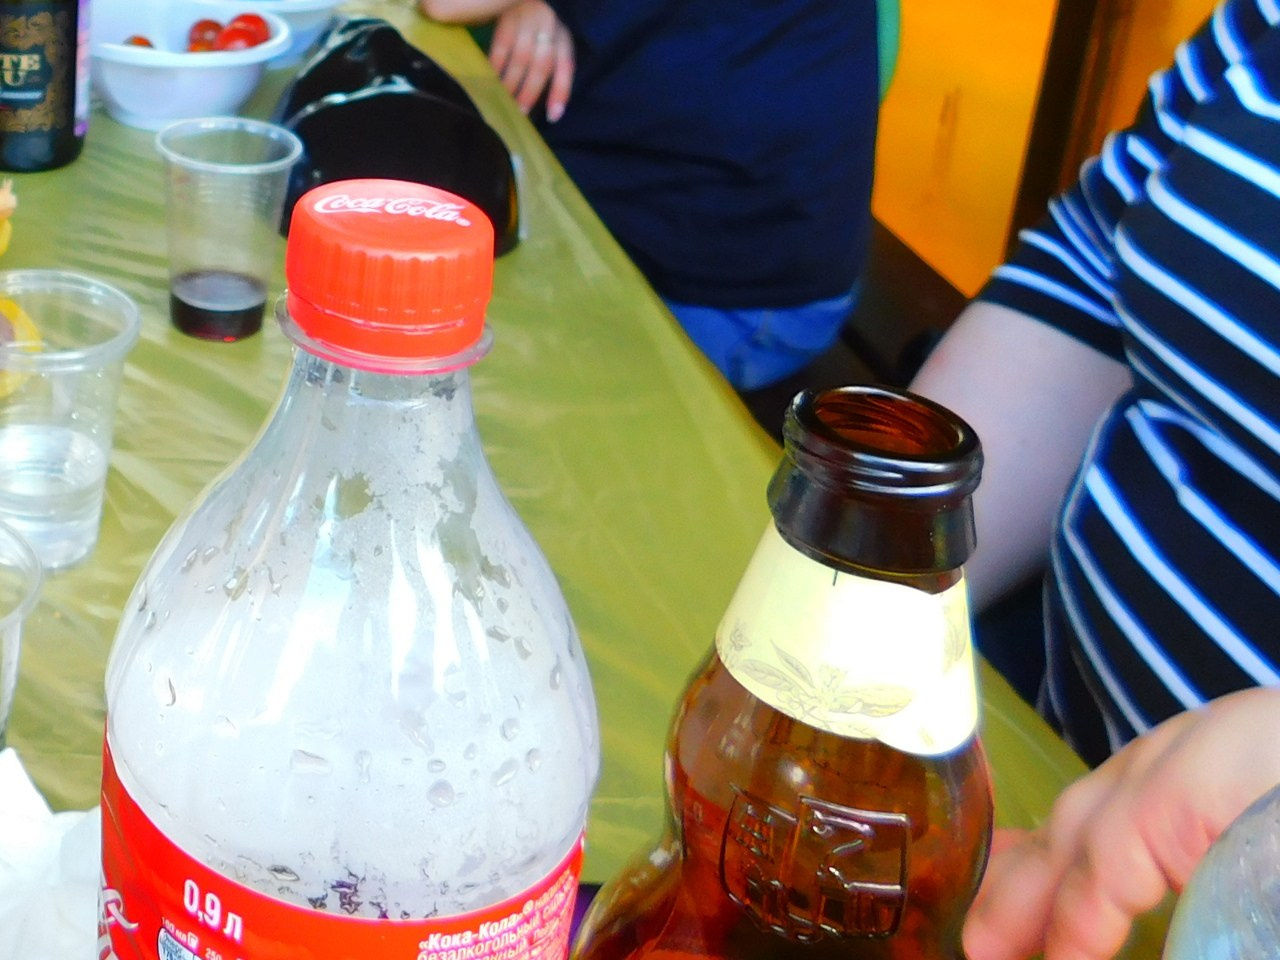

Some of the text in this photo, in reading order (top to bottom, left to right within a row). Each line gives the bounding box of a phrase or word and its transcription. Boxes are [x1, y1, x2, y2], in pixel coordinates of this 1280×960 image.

[314, 195, 466, 222] Coca-Cola
[183, 879, 221, 927] 0,9
[223, 911, 243, 943] л
